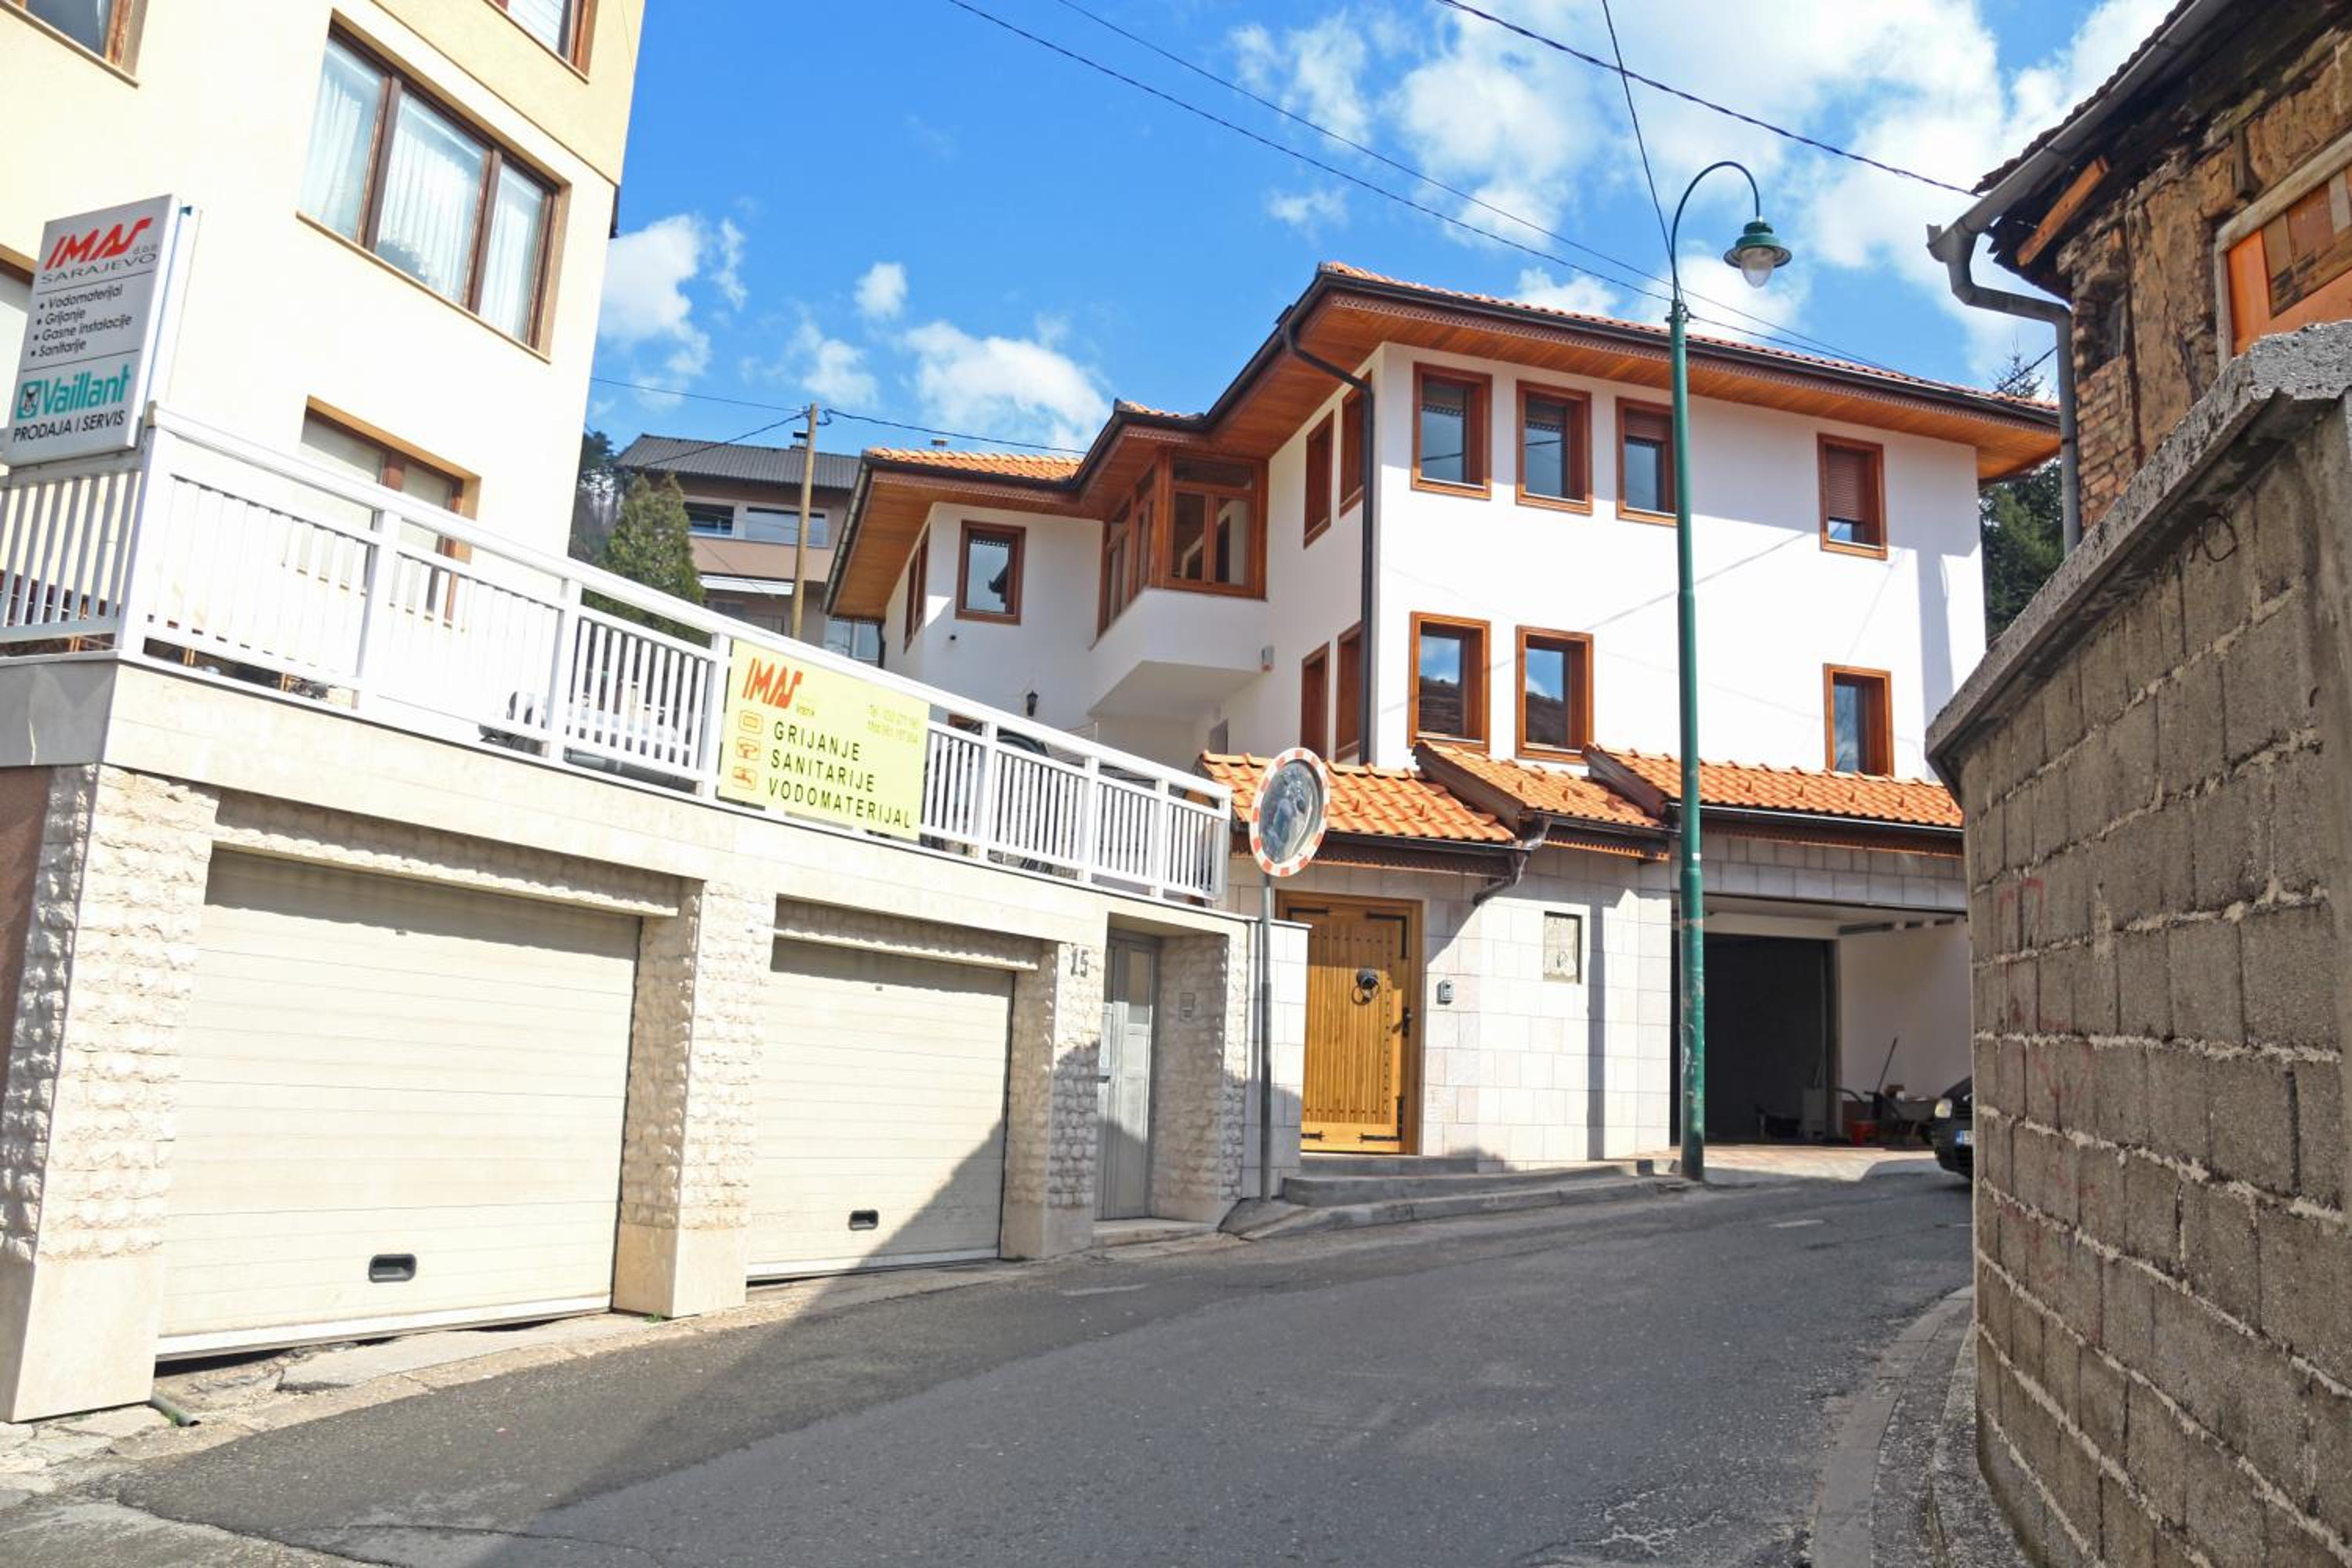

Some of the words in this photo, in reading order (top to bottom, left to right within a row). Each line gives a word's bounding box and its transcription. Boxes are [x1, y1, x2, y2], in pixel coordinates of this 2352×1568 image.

[45, 216, 153, 270] IMAS
[40, 252, 157, 284] SARAJEVO
[49, 283, 123, 309] Vodomaterijal
[42, 327, 76, 342] Gasne
[79, 314, 132, 335] instalacije
[45, 307, 86, 325] Grijanje
[38, 339, 86, 358] Sanitarije
[43, 363, 131, 415] Vaillant
[12, 419, 72, 443] PRODAJA
[82, 409, 125, 431] SERVIS
[742, 658, 804, 710] IMAS
[774, 720, 861, 762] GRIJANJE
[771, 749, 876, 793] SANITARIJE
[769, 777, 911, 829] VODOMATERIJAL
